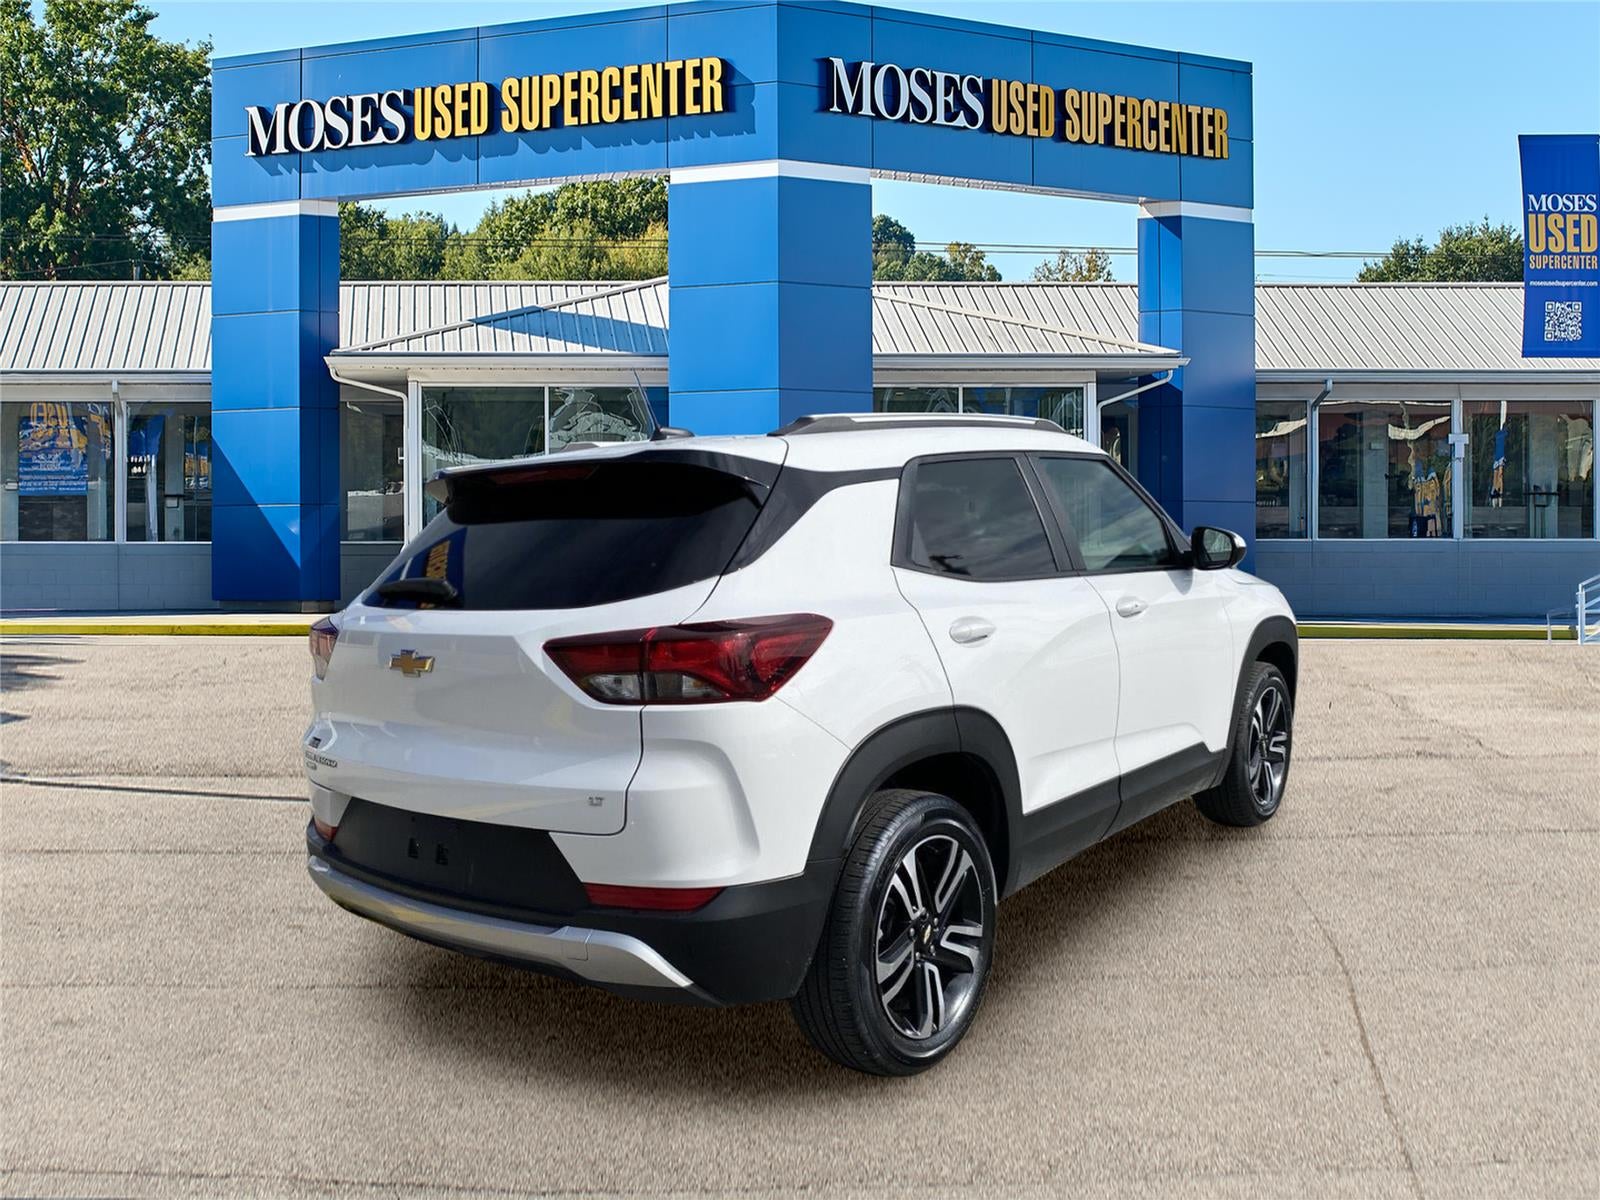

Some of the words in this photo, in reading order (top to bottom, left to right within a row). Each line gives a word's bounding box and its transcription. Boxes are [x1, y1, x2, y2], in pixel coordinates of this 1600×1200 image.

[244, 90, 408, 157] MOSES
[413, 81, 489, 141] USED
[501, 56, 724, 132] SUPERCENTER
[828, 57, 985, 130] MOSES
[991, 78, 1055, 138] USED
[1064, 88, 1229, 160] SUPERCENTER
[1528, 194, 1597, 212] MOSES
[1528, 214, 1598, 253] USED
[1529, 255, 1598, 270] SUPERCENTER
